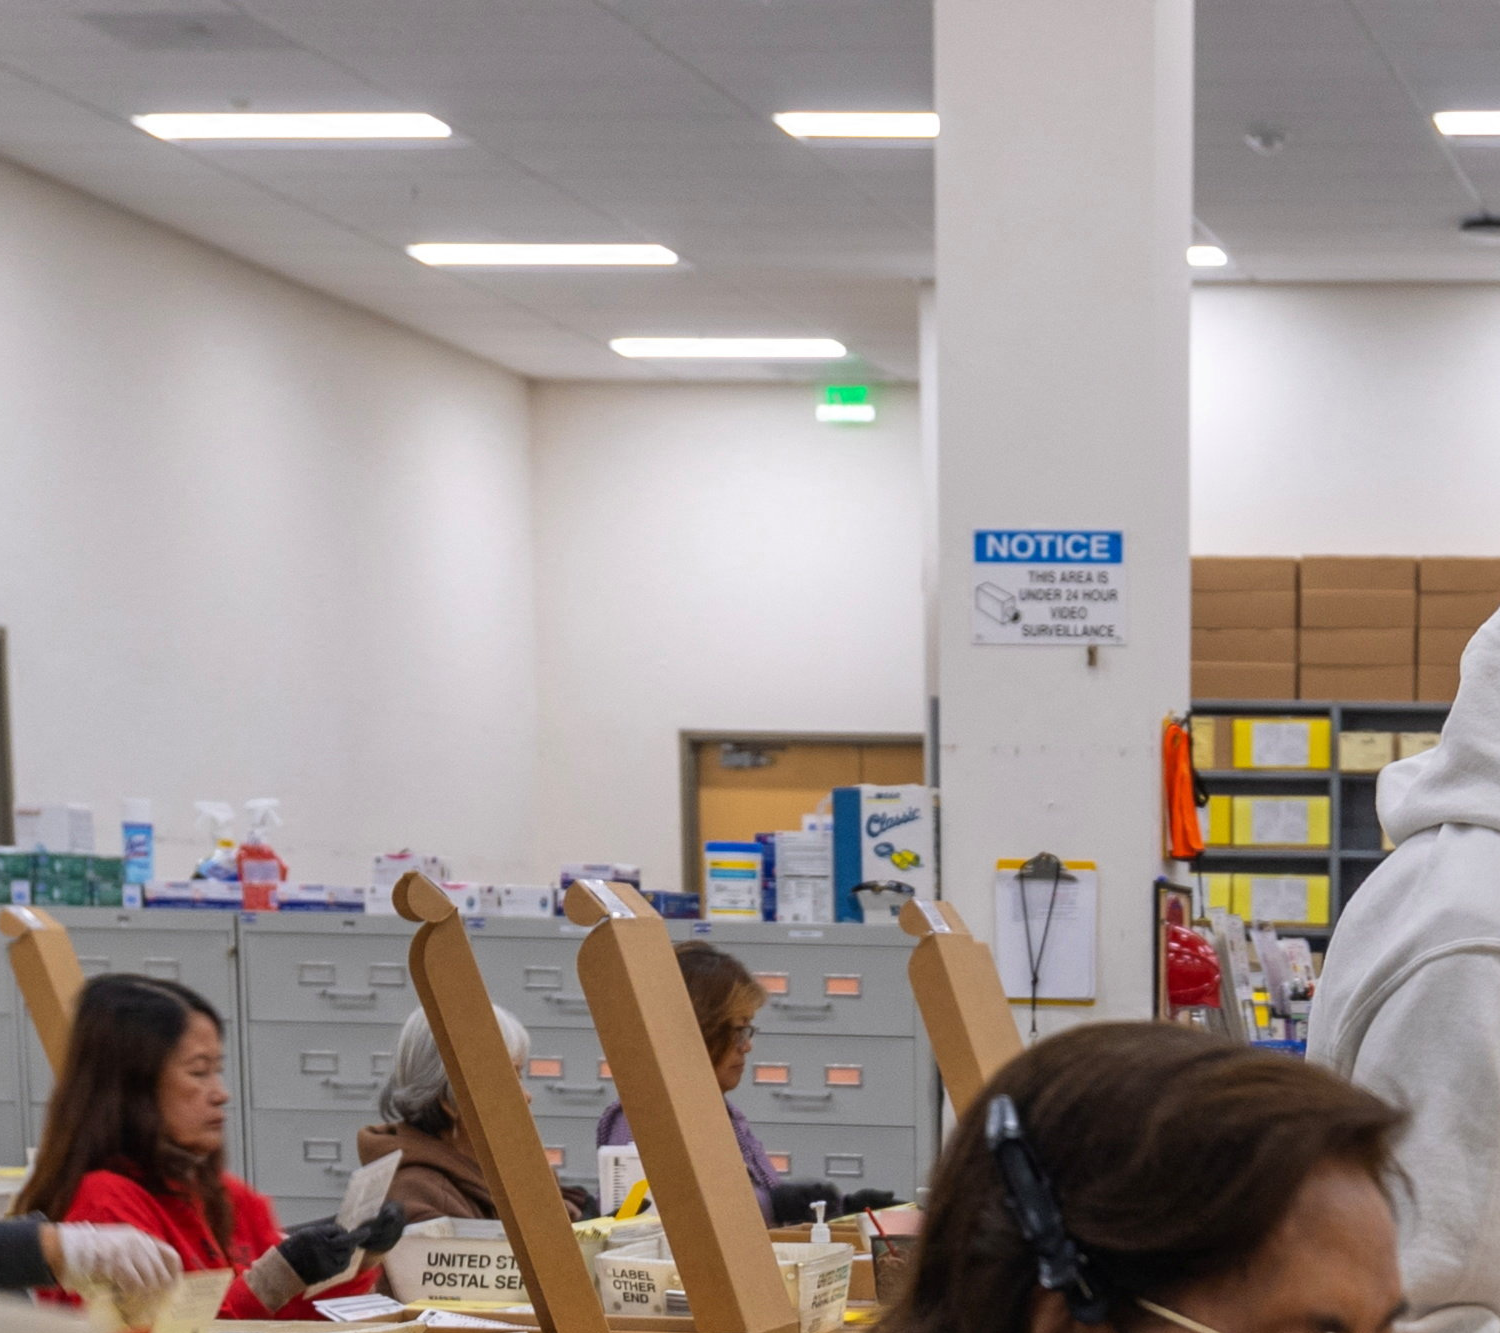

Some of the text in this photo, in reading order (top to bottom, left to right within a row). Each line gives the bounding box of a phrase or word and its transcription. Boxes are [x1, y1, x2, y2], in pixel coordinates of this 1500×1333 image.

[986, 534, 1110, 559] NOTICE
[1028, 571, 1109, 584] THIS AREA IS
[1019, 589, 1118, 601] UNDER 24 HOUR
[1051, 606, 1088, 619] VIDEO
[1022, 624, 1115, 637] SURVEILLANCE
[865, 807, 921, 838] Classic
[427, 1252, 491, 1269] UNITED
[422, 1272, 489, 1289] POSTAL
[612, 1268, 654, 1282] LABEL
[613, 1280, 656, 1293] OTHER
[623, 1291, 649, 1304] END
